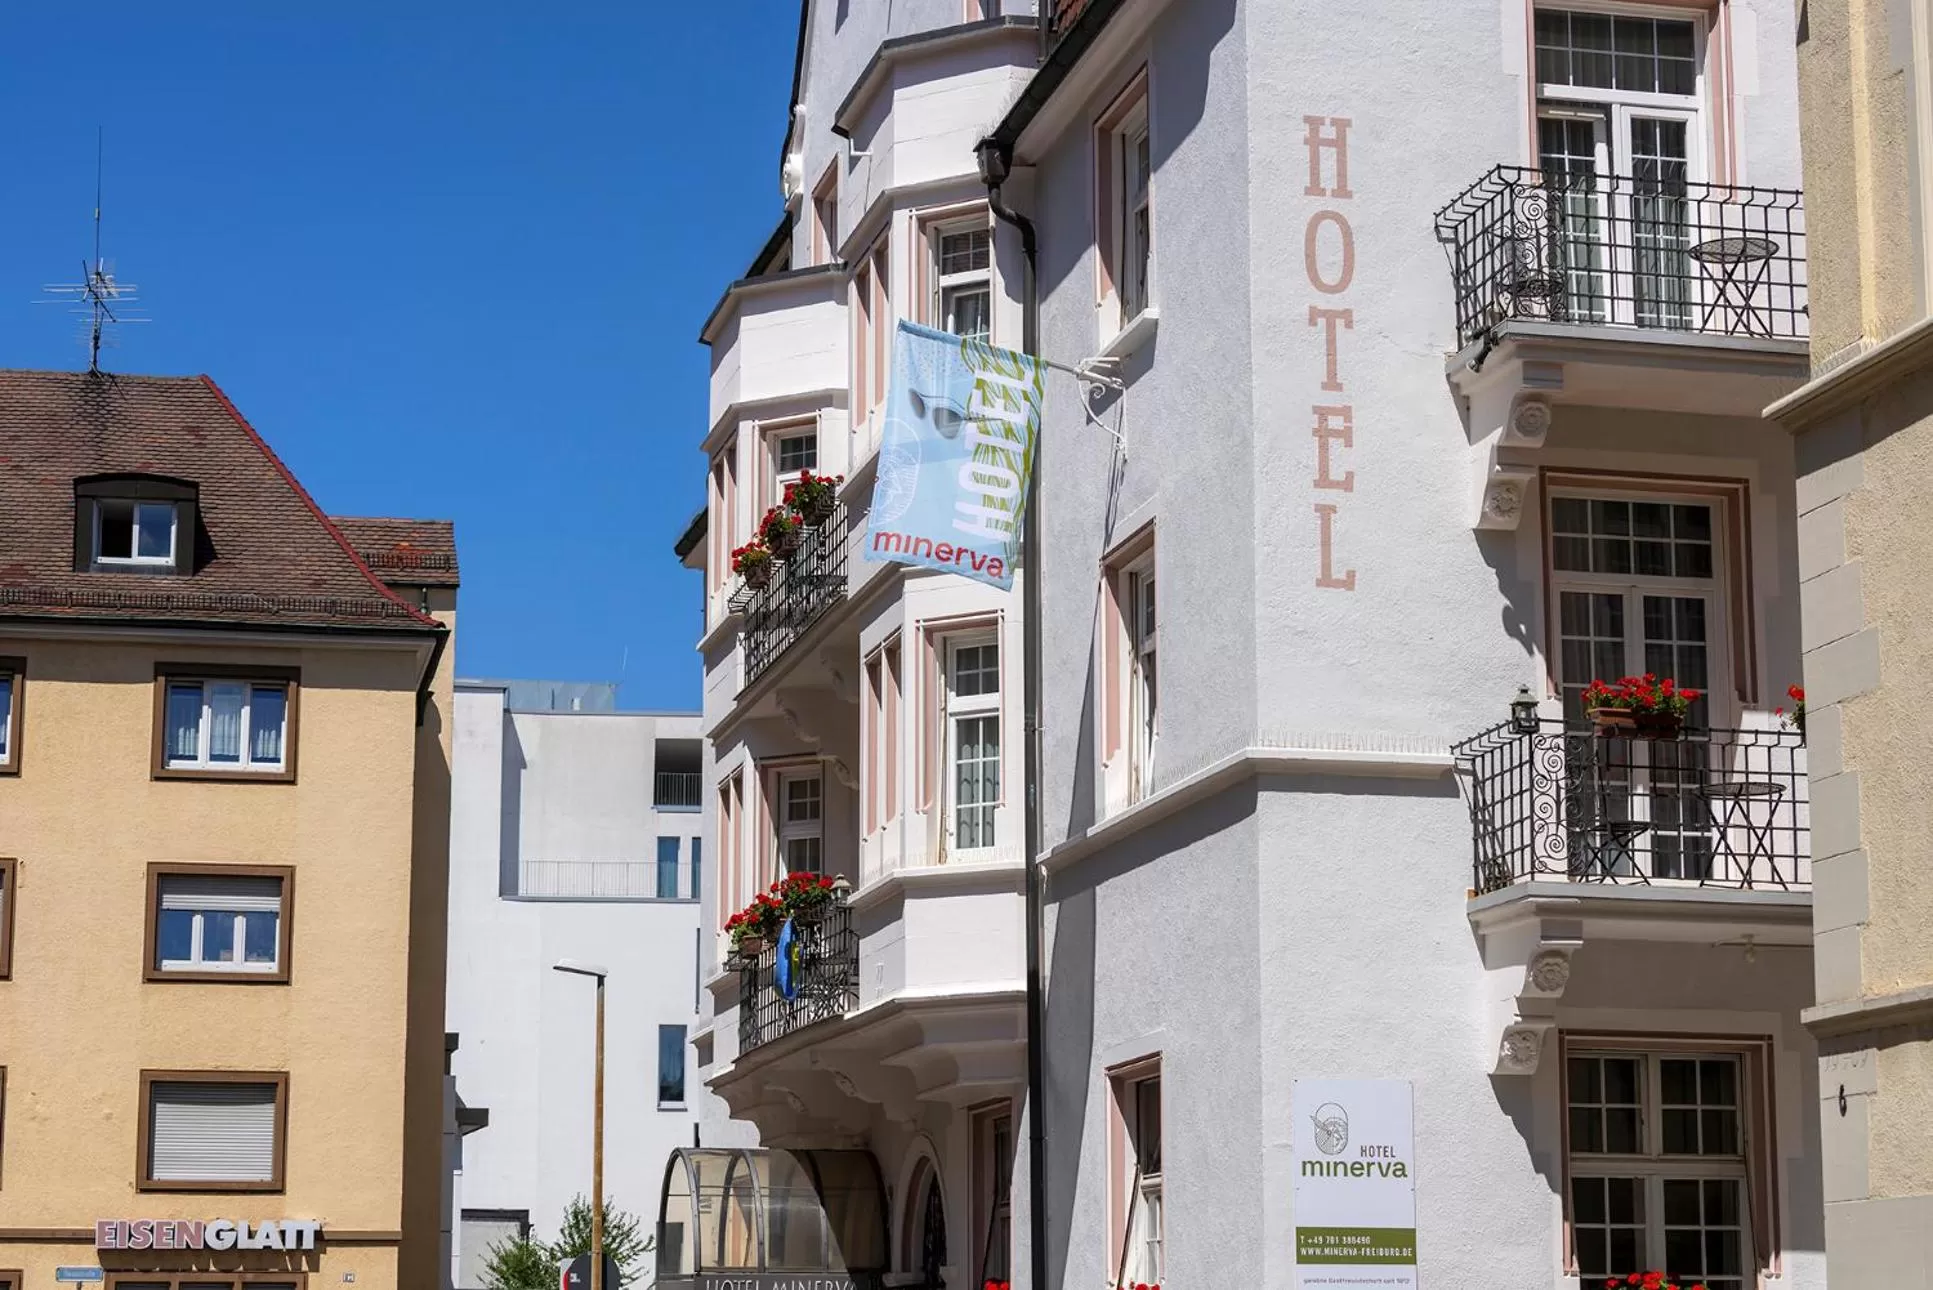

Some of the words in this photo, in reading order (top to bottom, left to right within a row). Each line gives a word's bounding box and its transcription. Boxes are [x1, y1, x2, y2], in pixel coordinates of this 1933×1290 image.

[1303, 115, 1356, 591] HOTEL
[953, 369, 1034, 541] HOTEL
[873, 531, 1004, 579] minerva
[1360, 1145, 1397, 1158] HOTEL
[1301, 1160, 1408, 1178] minerva
[95, 1218, 321, 1251] EISENGLATT
[1308, 1236, 1323, 1244] +49
